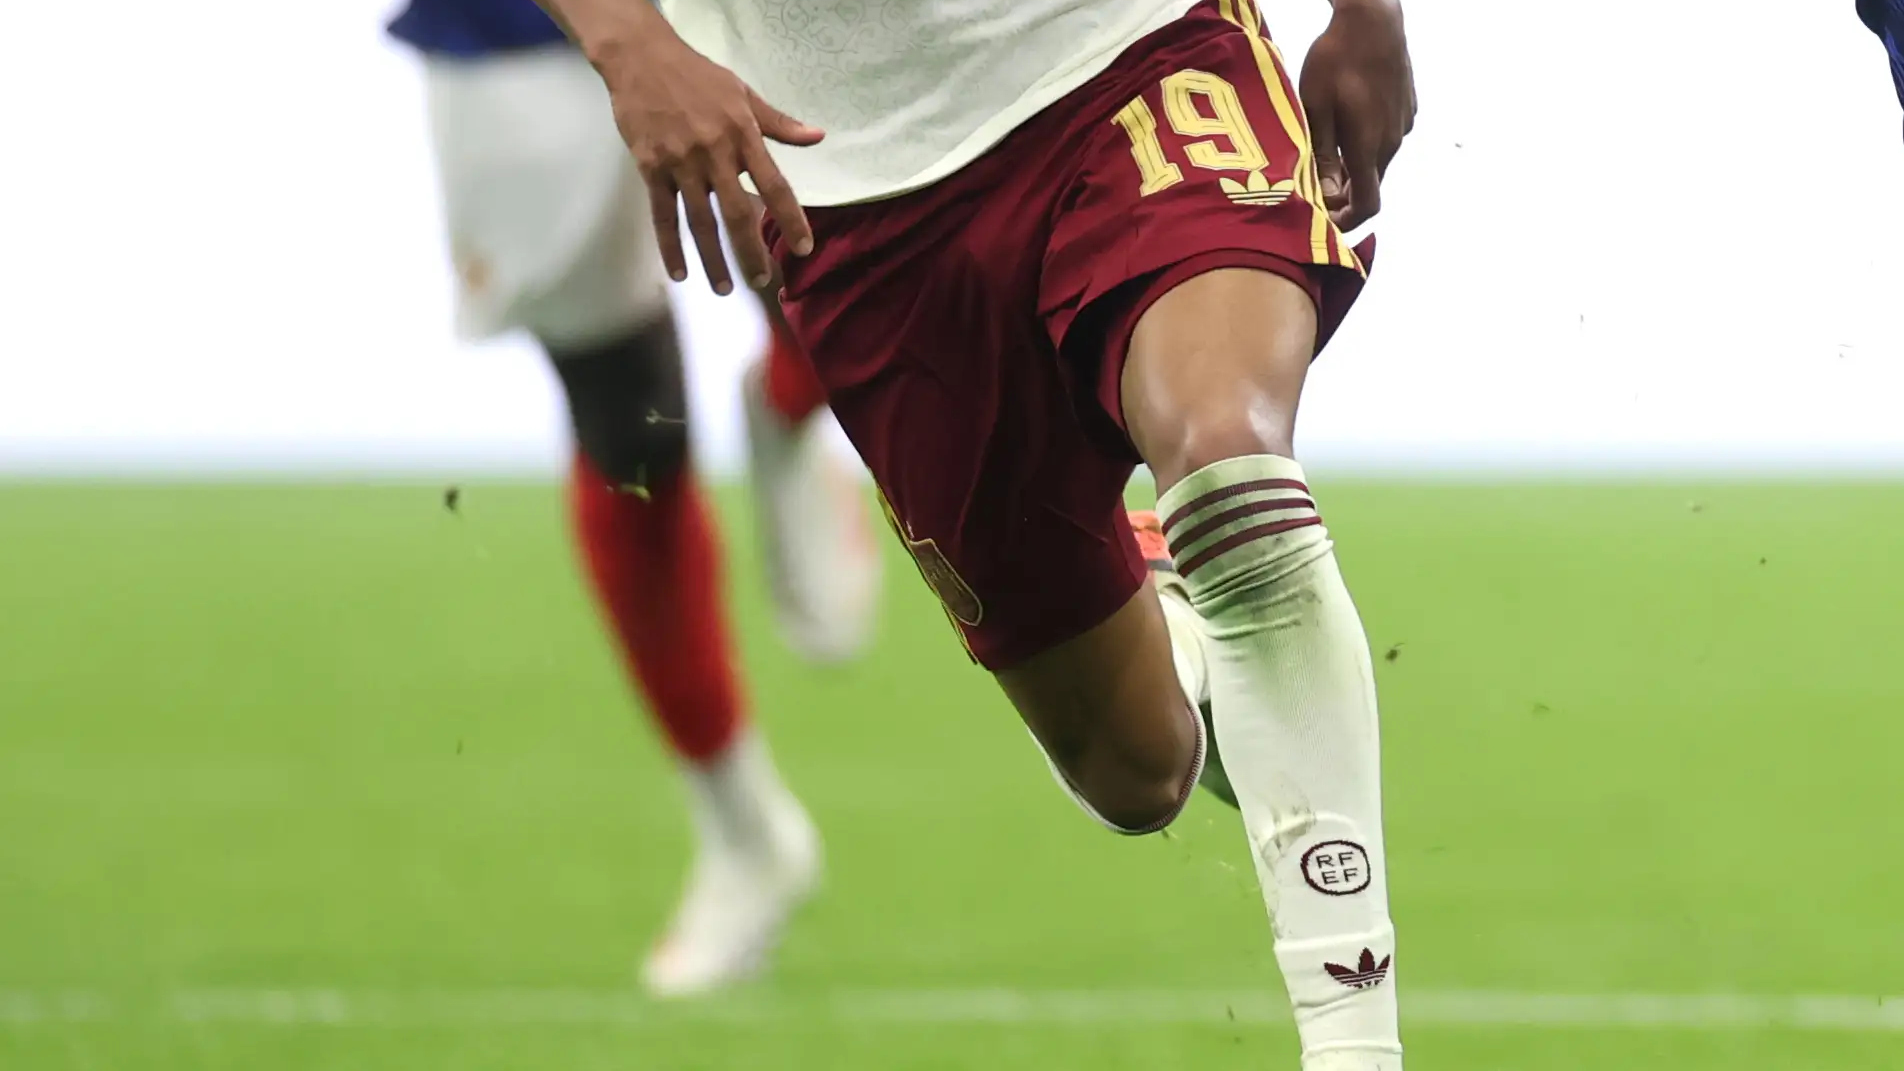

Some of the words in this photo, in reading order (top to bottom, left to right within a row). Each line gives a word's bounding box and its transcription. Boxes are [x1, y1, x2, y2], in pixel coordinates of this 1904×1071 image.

[1110, 68, 1269, 197] 19
[1316, 852, 1354, 869] RF
[1321, 868, 1359, 885] EF
